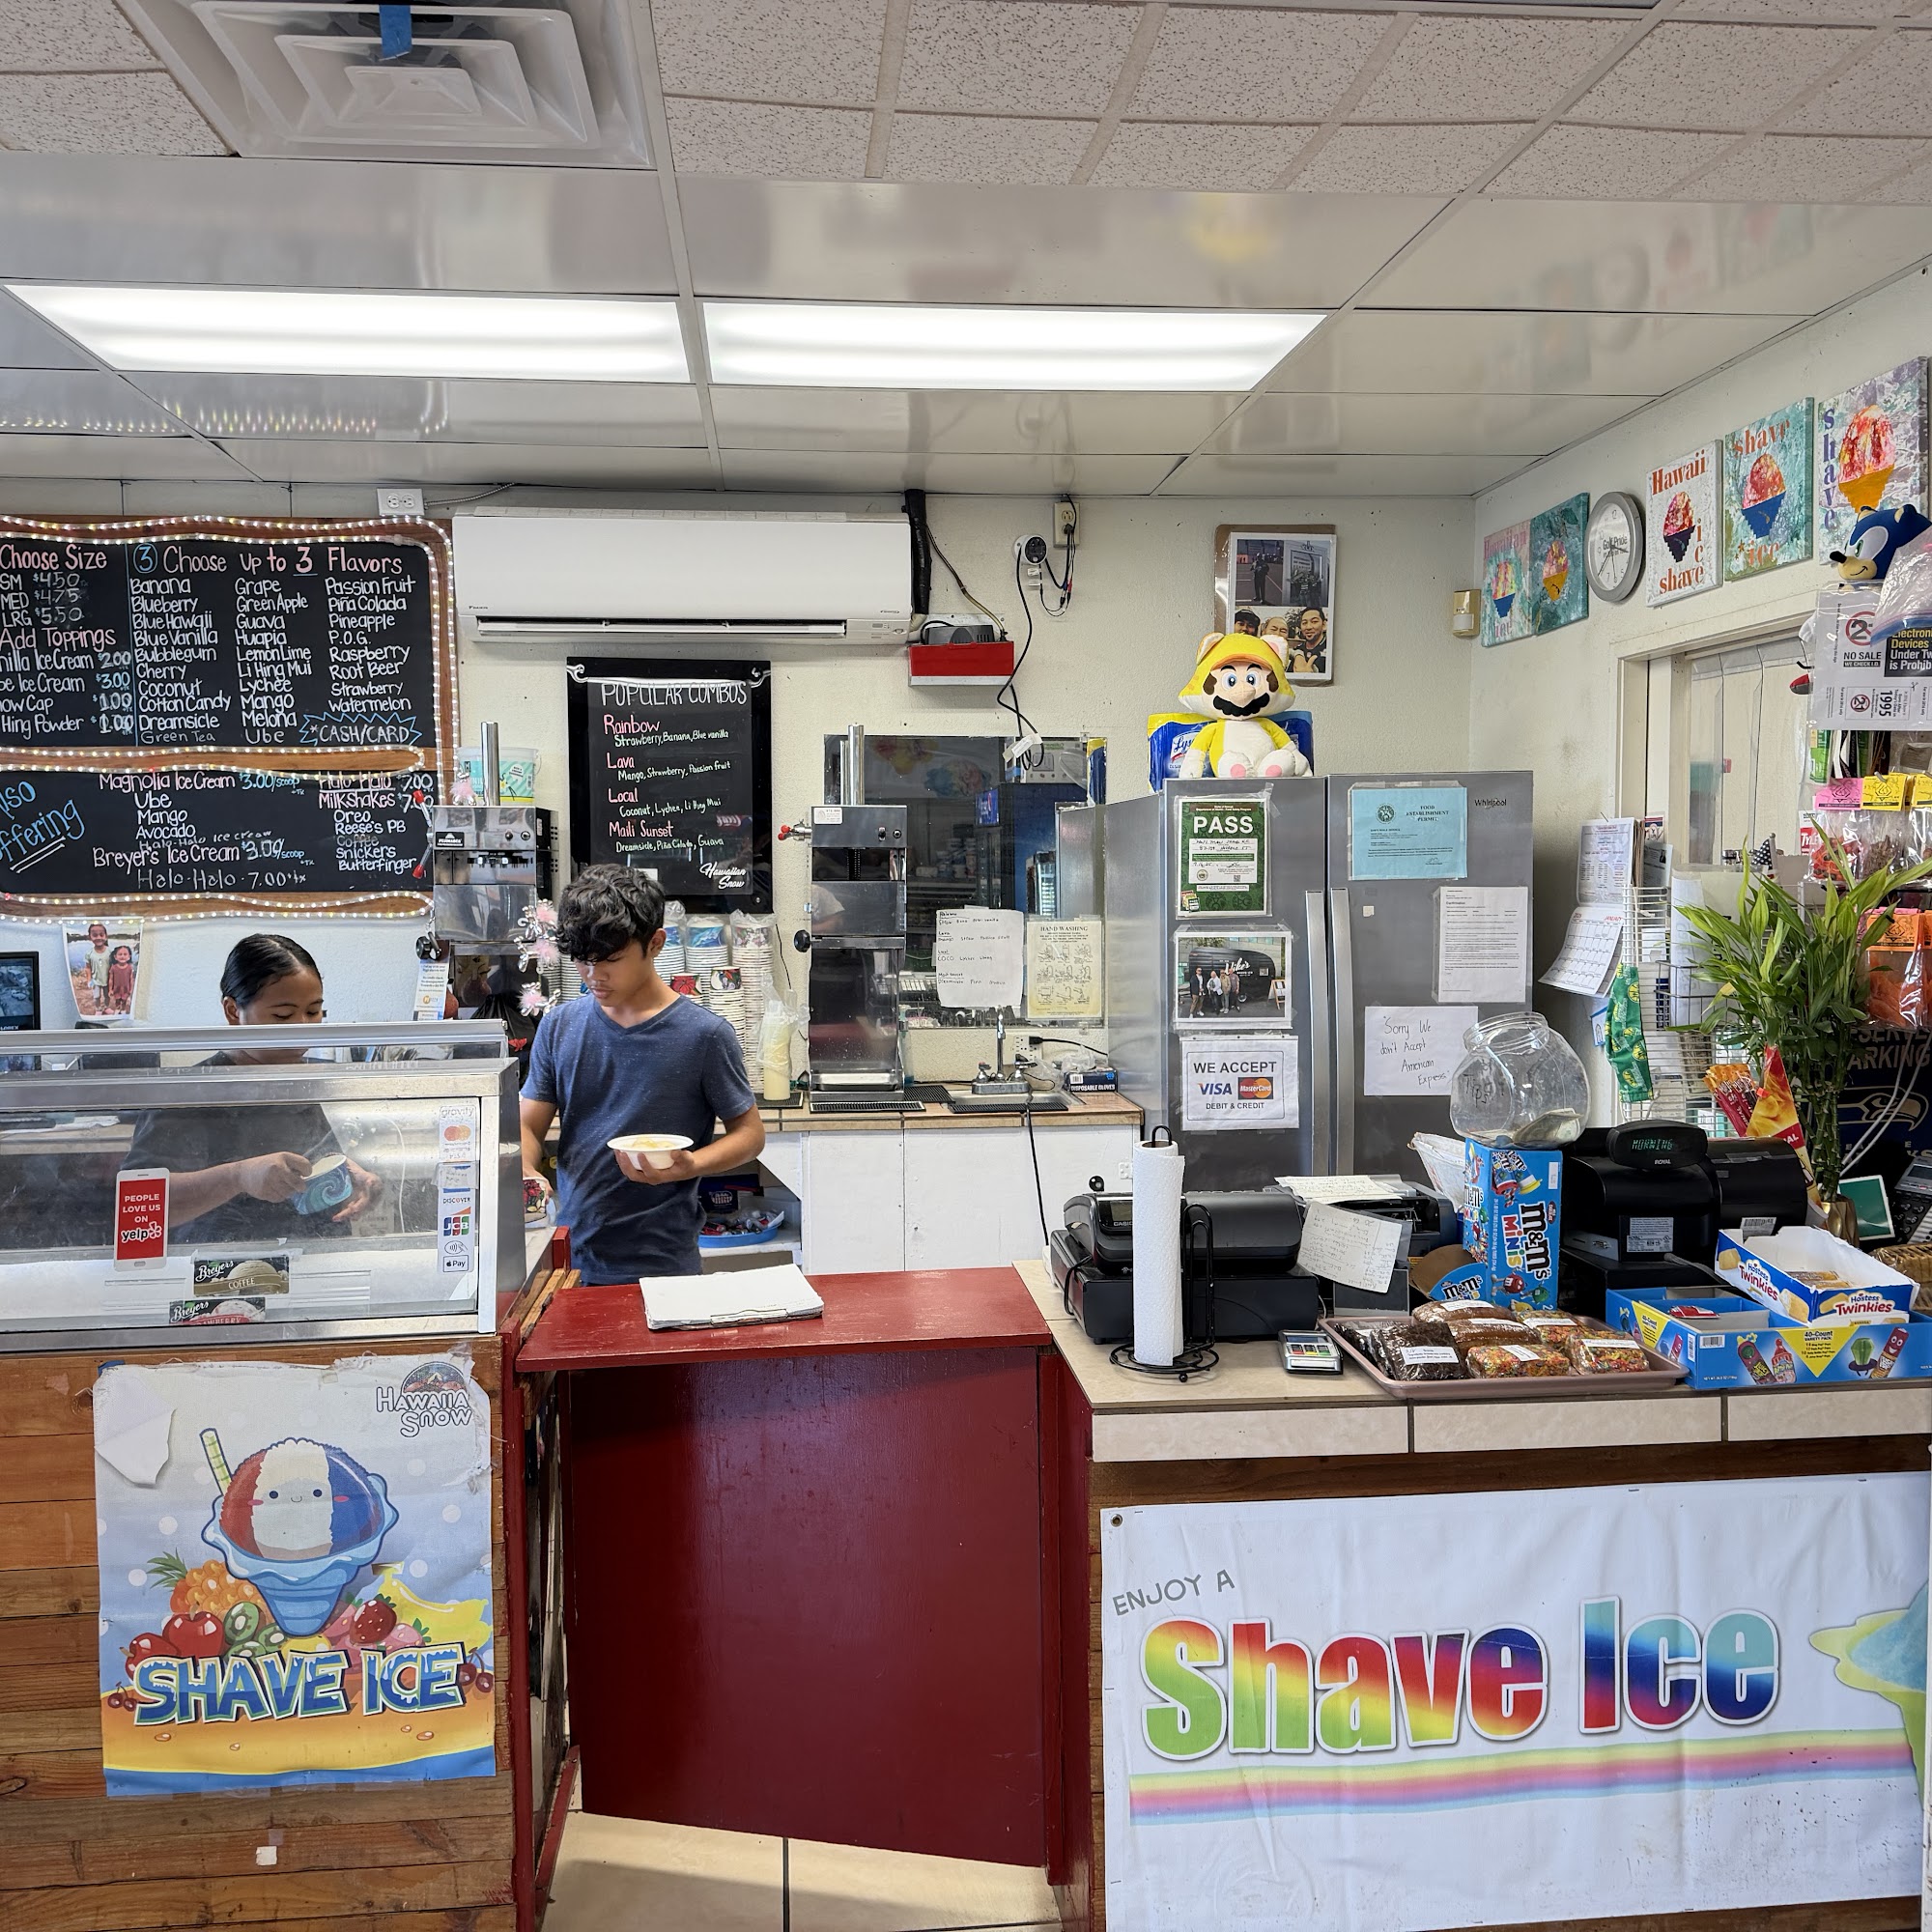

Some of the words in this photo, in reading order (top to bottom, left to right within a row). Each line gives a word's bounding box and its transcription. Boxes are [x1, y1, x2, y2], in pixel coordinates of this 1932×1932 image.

[1734, 419, 1790, 458] shave
[1652, 449, 1707, 496] Hawaii
[0, 544, 59, 570] Choose
[65, 544, 107, 570] Size
[163, 545, 227, 573] Choose
[240, 553, 262, 575] Up
[267, 547, 287, 572] to
[296, 547, 313, 573] 3
[327, 547, 403, 574] Flavors
[1748, 540, 1780, 566] ice
[0, 573, 22, 590] SM
[130, 578, 191, 595] Banana
[235, 578, 282, 598] Grape
[325, 577, 381, 595] Passion
[382, 575, 416, 594] Fruit
[1659, 566, 1704, 594] shave
[0, 592, 30, 611] MED
[131, 595, 198, 612] Blueberry
[237, 596, 276, 612] Green
[276, 592, 309, 613] Apple
[357, 594, 407, 612] Colada
[2, 610, 32, 628] LRG
[132, 613, 165, 630] Blue
[165, 611, 213, 630] Hawaii
[237, 613, 285, 629] Guava
[328, 613, 395, 632] Pineapple
[0, 628, 36, 650] Add
[42, 626, 116, 652] Toppings
[133, 630, 168, 647] Blue
[168, 627, 218, 645] Vanilla
[235, 628, 287, 649] Huapia
[328, 630, 371, 644] P.O.G.
[1890, 639, 1929, 648] Devices
[135, 646, 216, 663] Bubblegum
[237, 646, 280, 662] Lemon
[280, 645, 311, 661] Lime
[329, 645, 410, 664] Raspberry
[1890, 650, 1919, 659] Under
[136, 663, 186, 680] Cherry
[238, 663, 251, 677] Li
[254, 662, 286, 681] Hing
[287, 661, 312, 677] Mui
[329, 663, 364, 680] Root
[367, 662, 404, 678] Beer
[1889, 660, 1898, 669] is
[38, 672, 85, 693] Cream
[138, 678, 203, 697] Coconut
[240, 677, 293, 695] Lychee
[330, 681, 403, 696] Strawberry
[139, 696, 185, 713] Cotton
[185, 690, 231, 712] Candy
[601, 682, 682, 706] POPULAR
[26, 695, 54, 715] Cap
[241, 694, 295, 714] Mango
[328, 696, 412, 712] Watermelon
[1879, 691, 1893, 716] 1995
[2, 715, 32, 740] Hing
[35, 714, 84, 733] Powder
[138, 713, 220, 731] Dreamsicle
[242, 709, 297, 727] Melona
[604, 713, 661, 735] Rainbow
[141, 731, 188, 744] Green
[191, 730, 215, 742] Tea
[245, 728, 285, 745] Ube
[606, 753, 635, 769] Lava
[99, 772, 170, 793] Magnolia
[194, 771, 236, 789] Cream
[134, 790, 172, 809] Ube
[608, 787, 639, 804] Local
[1474, 799, 1507, 808] Whirlpool
[137, 810, 187, 826] Mango
[334, 810, 371, 823] Oreo
[1193, 816, 1254, 834] PASS
[135, 823, 196, 840] Avocado
[335, 821, 384, 835] Reese's
[387, 820, 406, 834] PB
[609, 821, 636, 838] Maili
[639, 819, 674, 838] Sunset
[697, 834, 724, 847] Guava
[93, 847, 159, 874] Breyer's
[167, 844, 188, 864] Ice
[190, 844, 240, 863] Cream
[338, 857, 416, 875] Butterfinger
[699, 861, 746, 880] Hawaiian
[719, 876, 745, 890] Snow
[1419, 1019, 1432, 1033] We
[1404, 1037, 1427, 1052] Accept
[1194, 1063, 1215, 1073] WE
[1219, 1062, 1276, 1073] ACCEPT
[1401, 1059, 1435, 1072] American
[1198, 1083, 1232, 1095] VISA
[440, 1107, 474, 1120] gravity
[124, 1194, 159, 1203] PEOPLE
[123, 1205, 146, 1213] LOVE
[122, 1228, 148, 1242] yelp
[195, 1261, 234, 1282] Breyers
[452, 1260, 466, 1268] Pay
[1747, 1263, 1769, 1281] Hostess
[228, 1277, 255, 1290] COFFEE
[1739, 1265, 1778, 1300] Twinkies
[171, 1300, 210, 1323] Breyers
[1835, 1303, 1892, 1315] Twinkies
[1113, 1574, 1202, 1616] ENJOY
[1217, 1570, 1236, 1592] A
[134, 1650, 350, 1726] SHAVE
[361, 1642, 466, 1716] ICE
[1142, 1616, 1548, 1762] Shave
[1578, 1596, 1780, 1734] Ice
